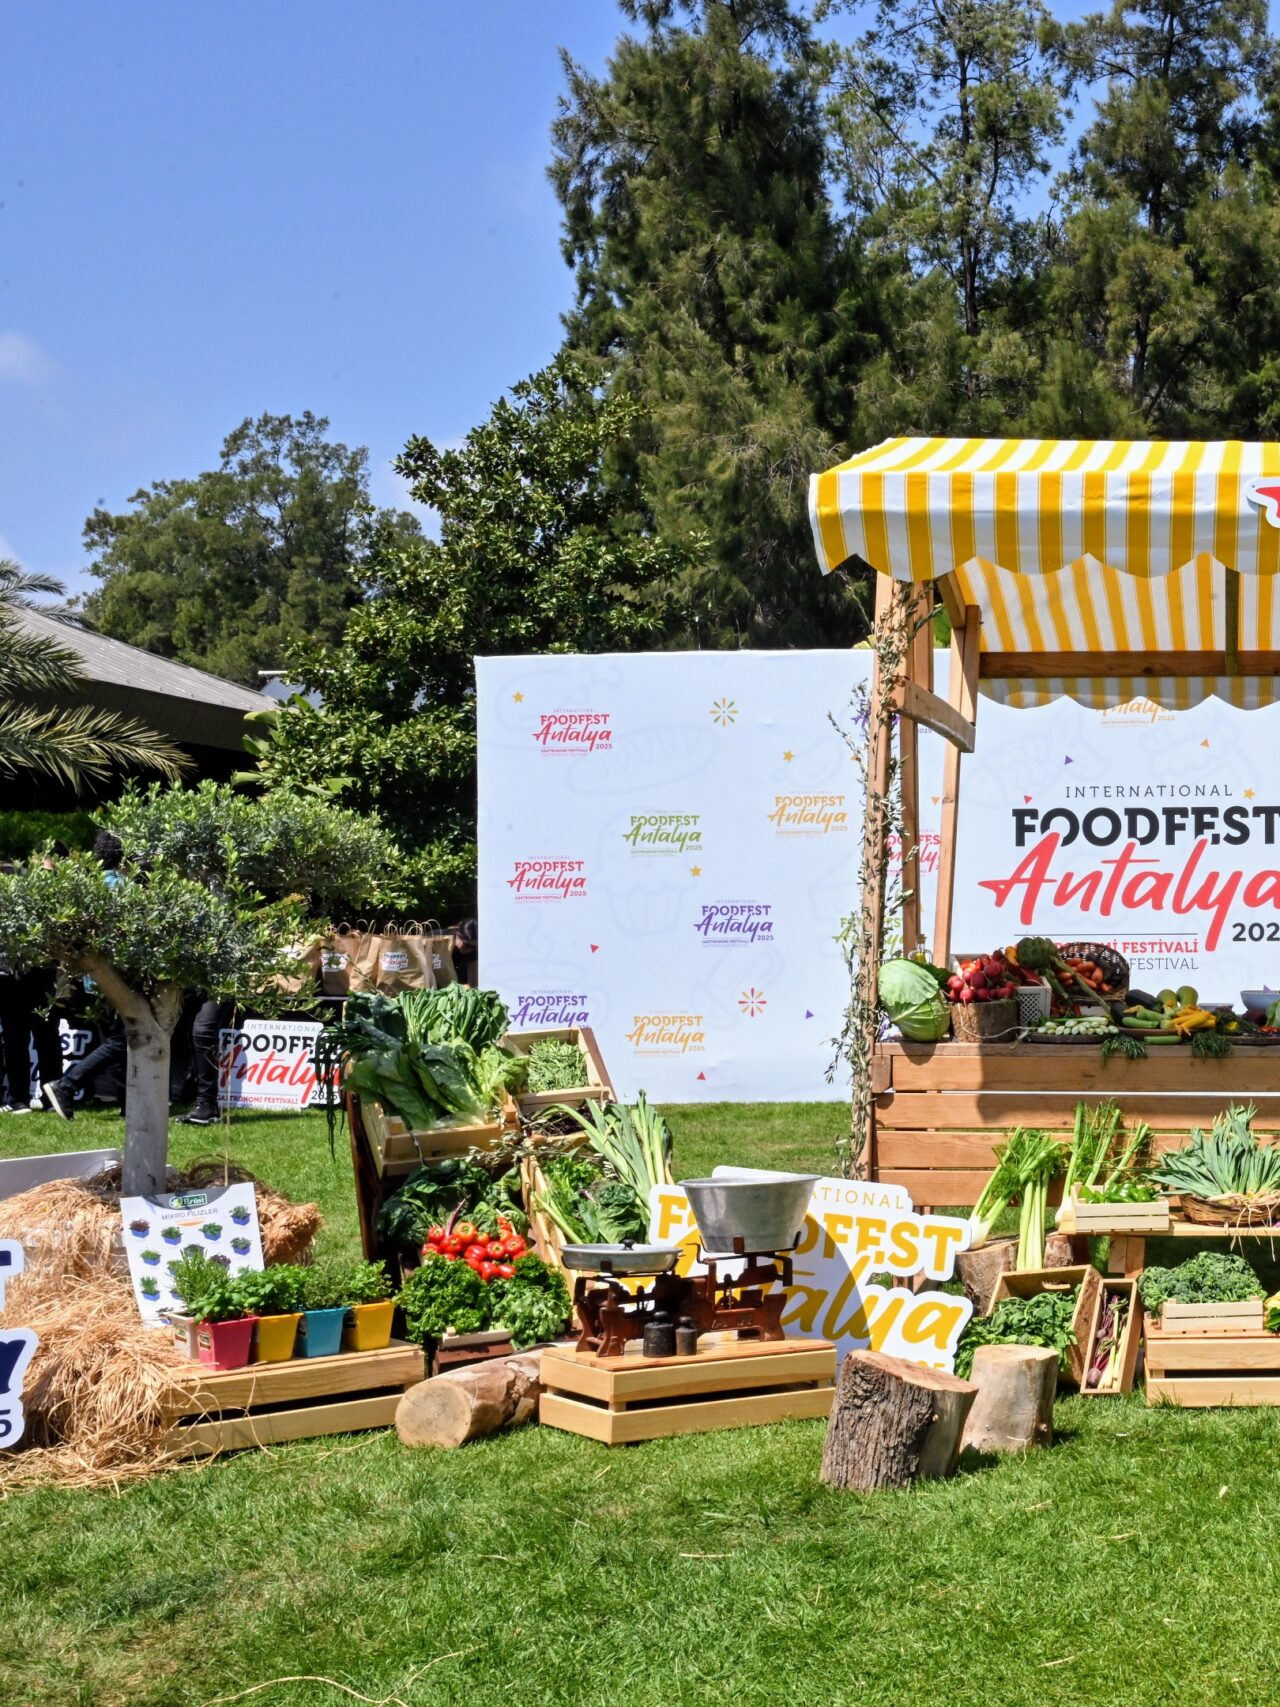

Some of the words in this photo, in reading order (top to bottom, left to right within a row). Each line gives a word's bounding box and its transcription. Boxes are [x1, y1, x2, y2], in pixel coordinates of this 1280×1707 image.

[540, 714, 610, 725] FOODFEST
[531, 721, 613, 752] Antalya
[1065, 785, 1233, 799] INTERNATIONAL
[775, 795, 846, 807] FOODFEST
[629, 815, 700, 826] FOODFEST
[766, 803, 848, 834] Antalya
[621, 822, 702, 853] Antalya
[515, 861, 584, 872] FOODFEST
[506, 868, 586, 899] Antalya
[701, 905, 771, 916] FOODFEST
[693, 911, 774, 943] Antalya
[1122, 938, 1199, 953] FESTİVALİ
[1129, 957, 1200, 970] FESTIVAL
[518, 996, 587, 1006] FOODFEST
[510, 1002, 589, 1027] Antalya
[633, 1016, 704, 1027] FOODFEST
[625, 1022, 705, 1054] Antalya
